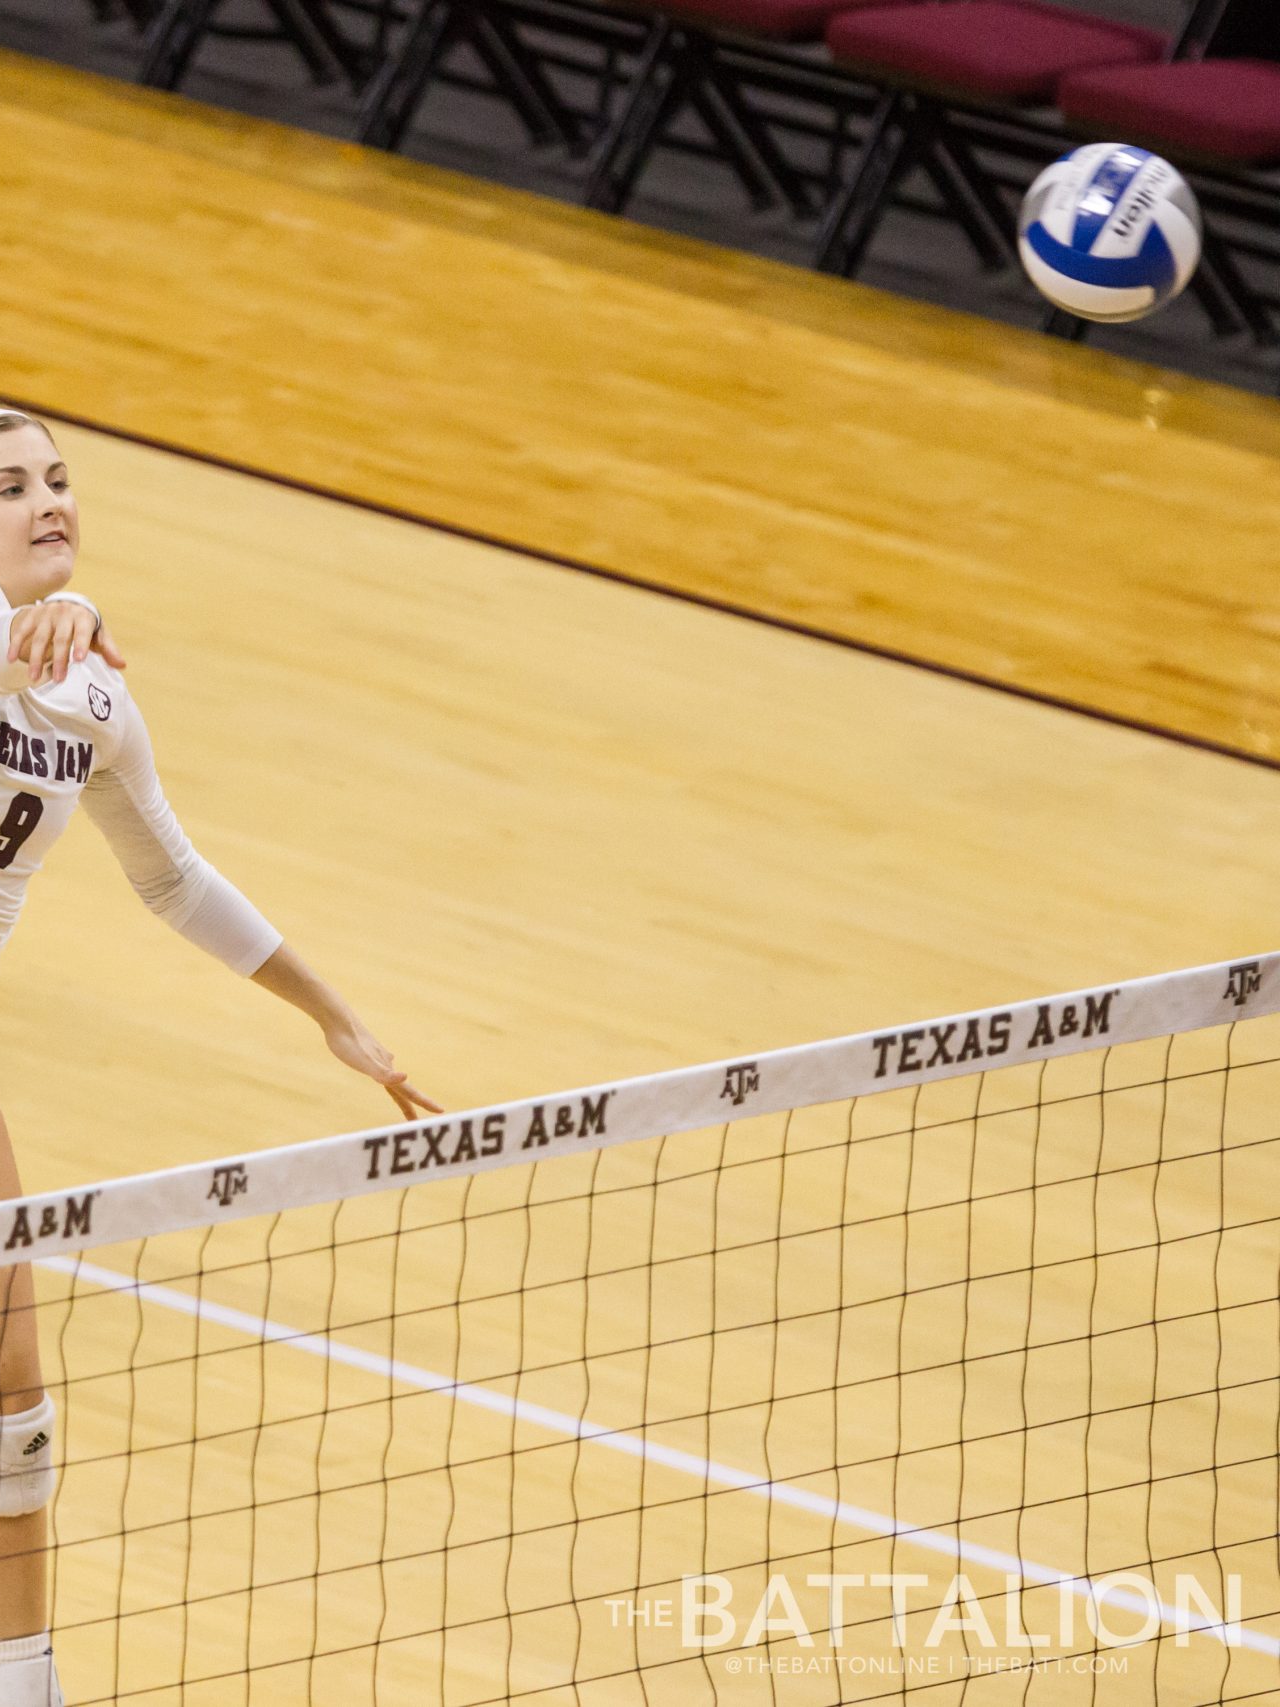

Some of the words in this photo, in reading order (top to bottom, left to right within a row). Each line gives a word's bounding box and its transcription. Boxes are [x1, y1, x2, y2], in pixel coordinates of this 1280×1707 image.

[873, 1012, 1012, 1078] TEXAS
[1027, 991, 1115, 1048] A&M
[363, 1113, 506, 1179] TEXAS
[522, 1092, 611, 1150] A&M
[4, 1192, 95, 1250] A&M
